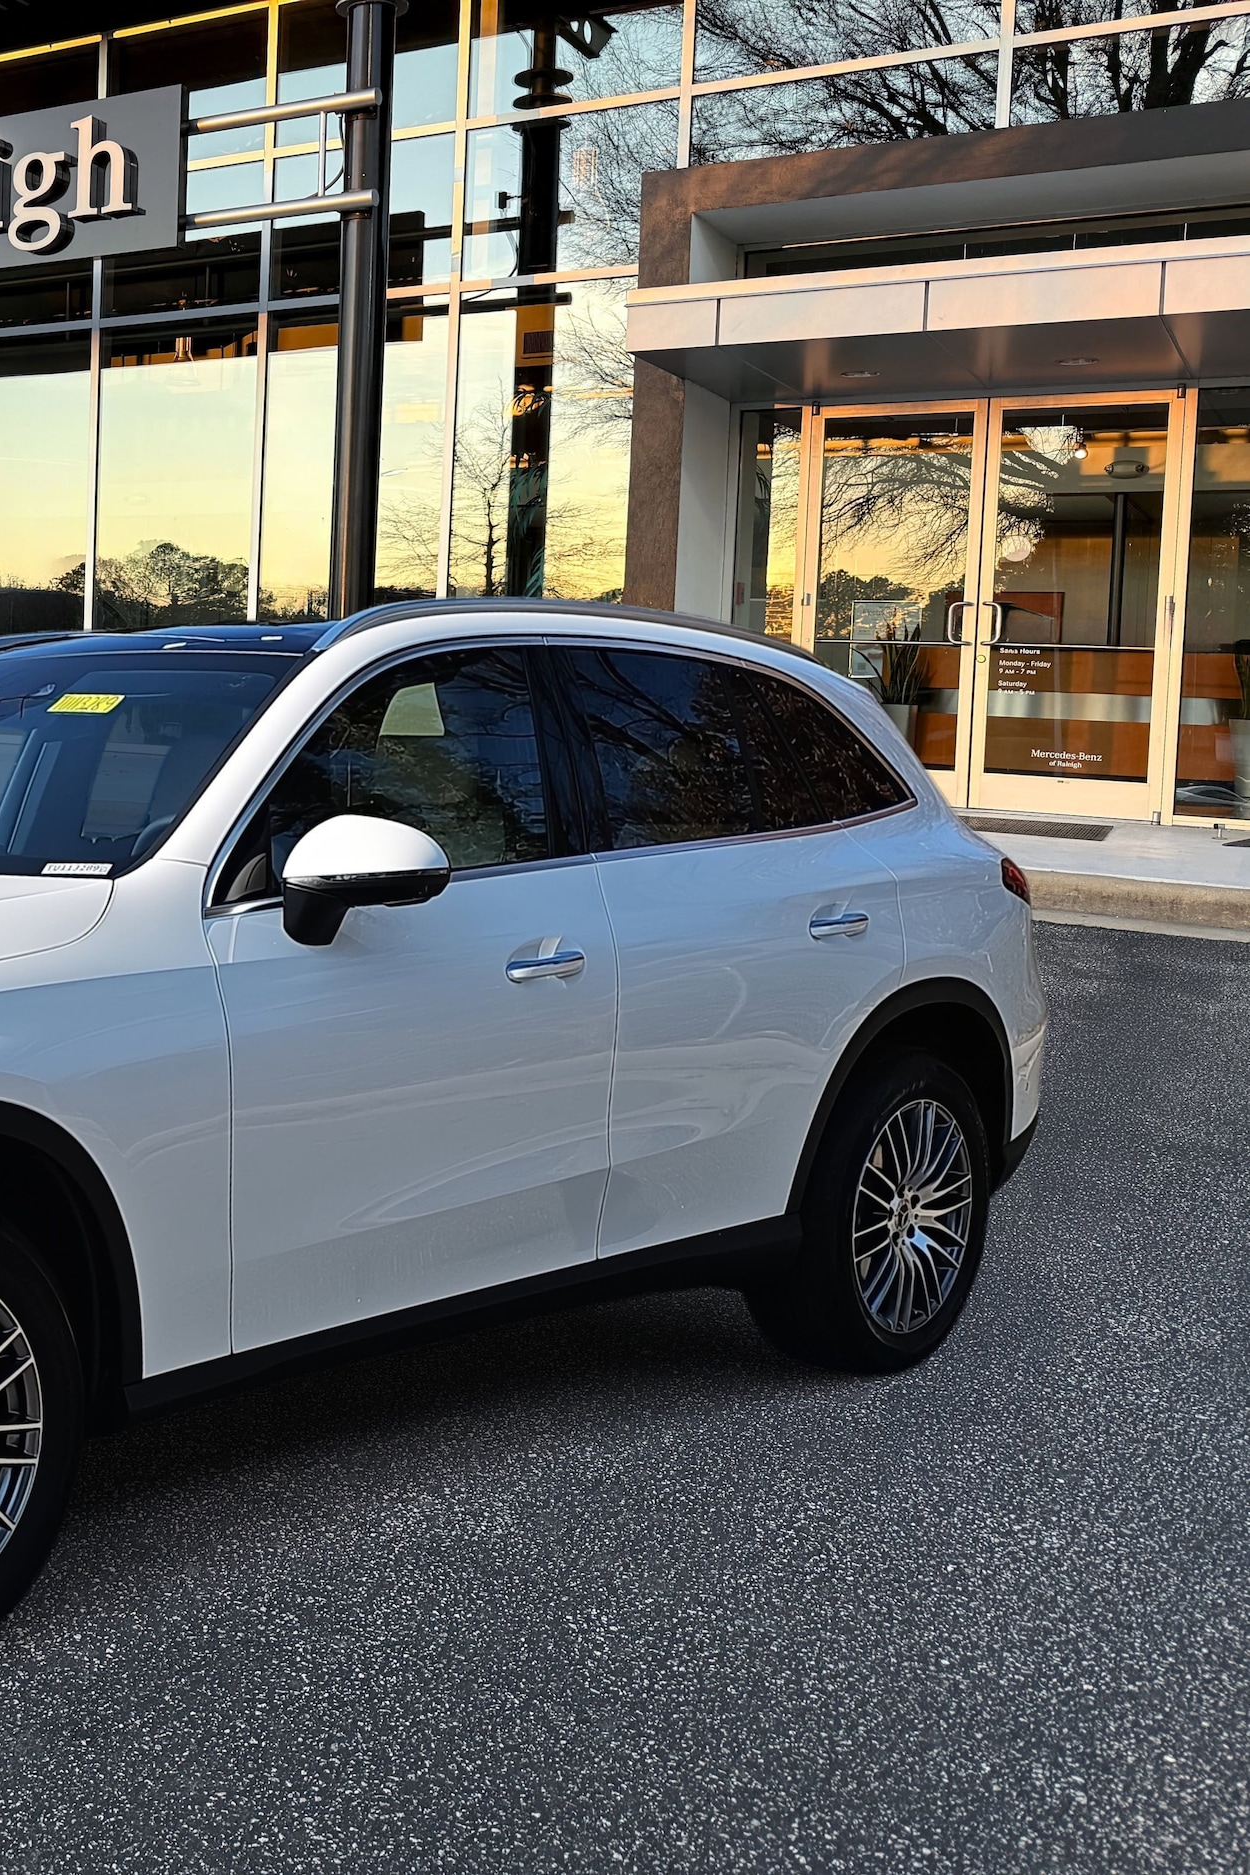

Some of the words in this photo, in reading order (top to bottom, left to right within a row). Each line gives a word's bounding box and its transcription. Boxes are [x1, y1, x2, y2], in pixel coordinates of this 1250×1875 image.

[998, 660, 1025, 668] Monday
[1030, 660, 1051, 668] Friday
[998, 680, 1027, 688] Saturday
[1031, 749, 1102, 761] Mercedes-Benz
[1057, 761, 1082, 769] Raleigh
